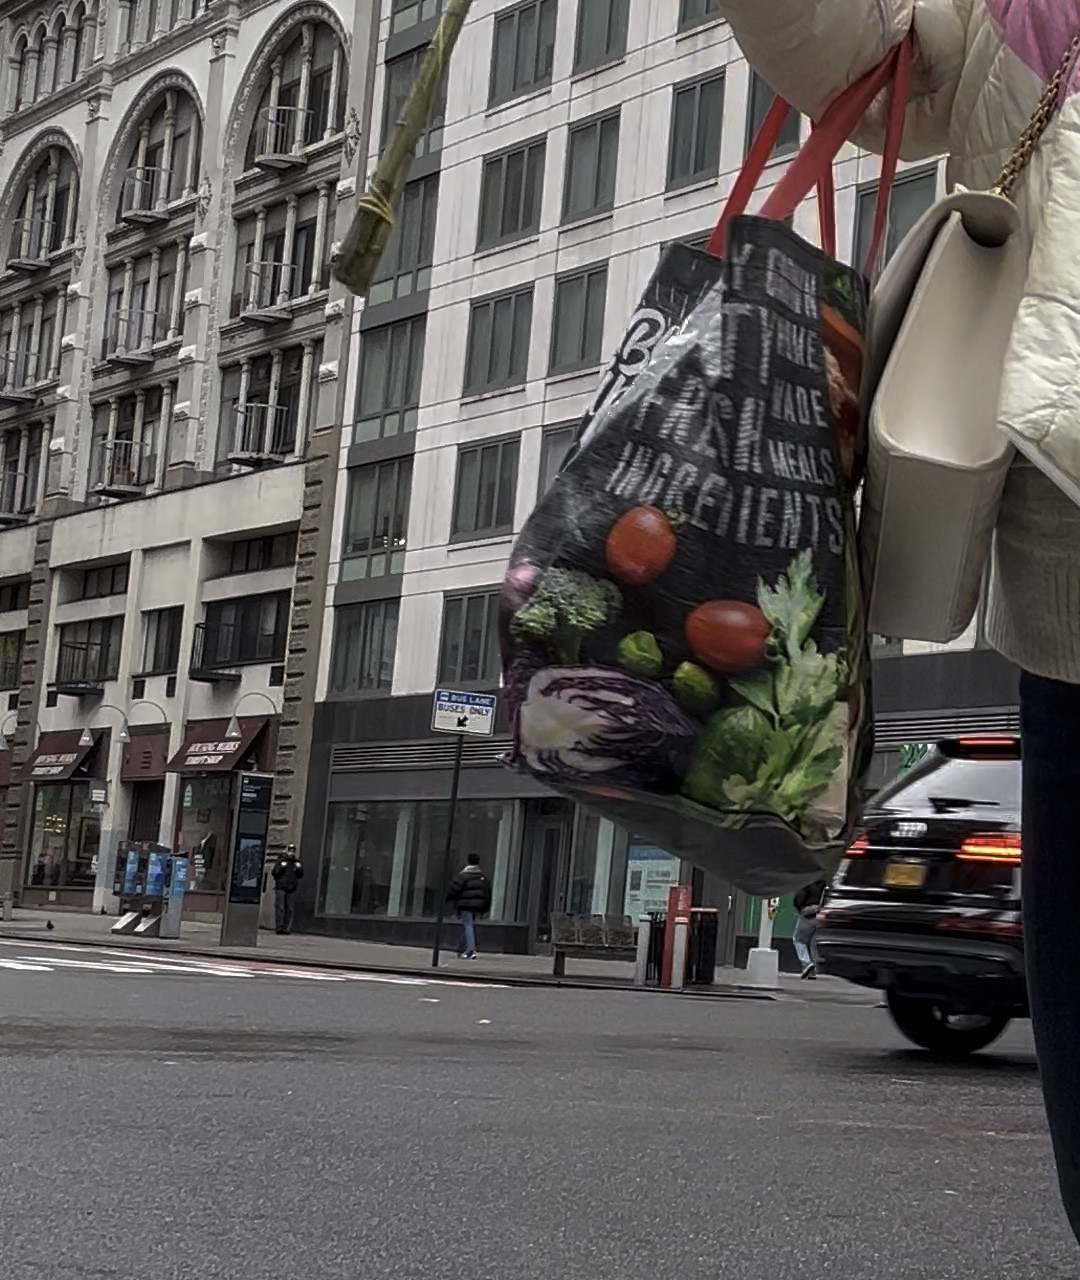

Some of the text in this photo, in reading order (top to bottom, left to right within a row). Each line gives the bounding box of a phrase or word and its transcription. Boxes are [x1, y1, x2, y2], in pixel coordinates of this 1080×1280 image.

[768, 438, 837, 487] MEALS
[438, 704, 490, 716] BUSES ONLY
